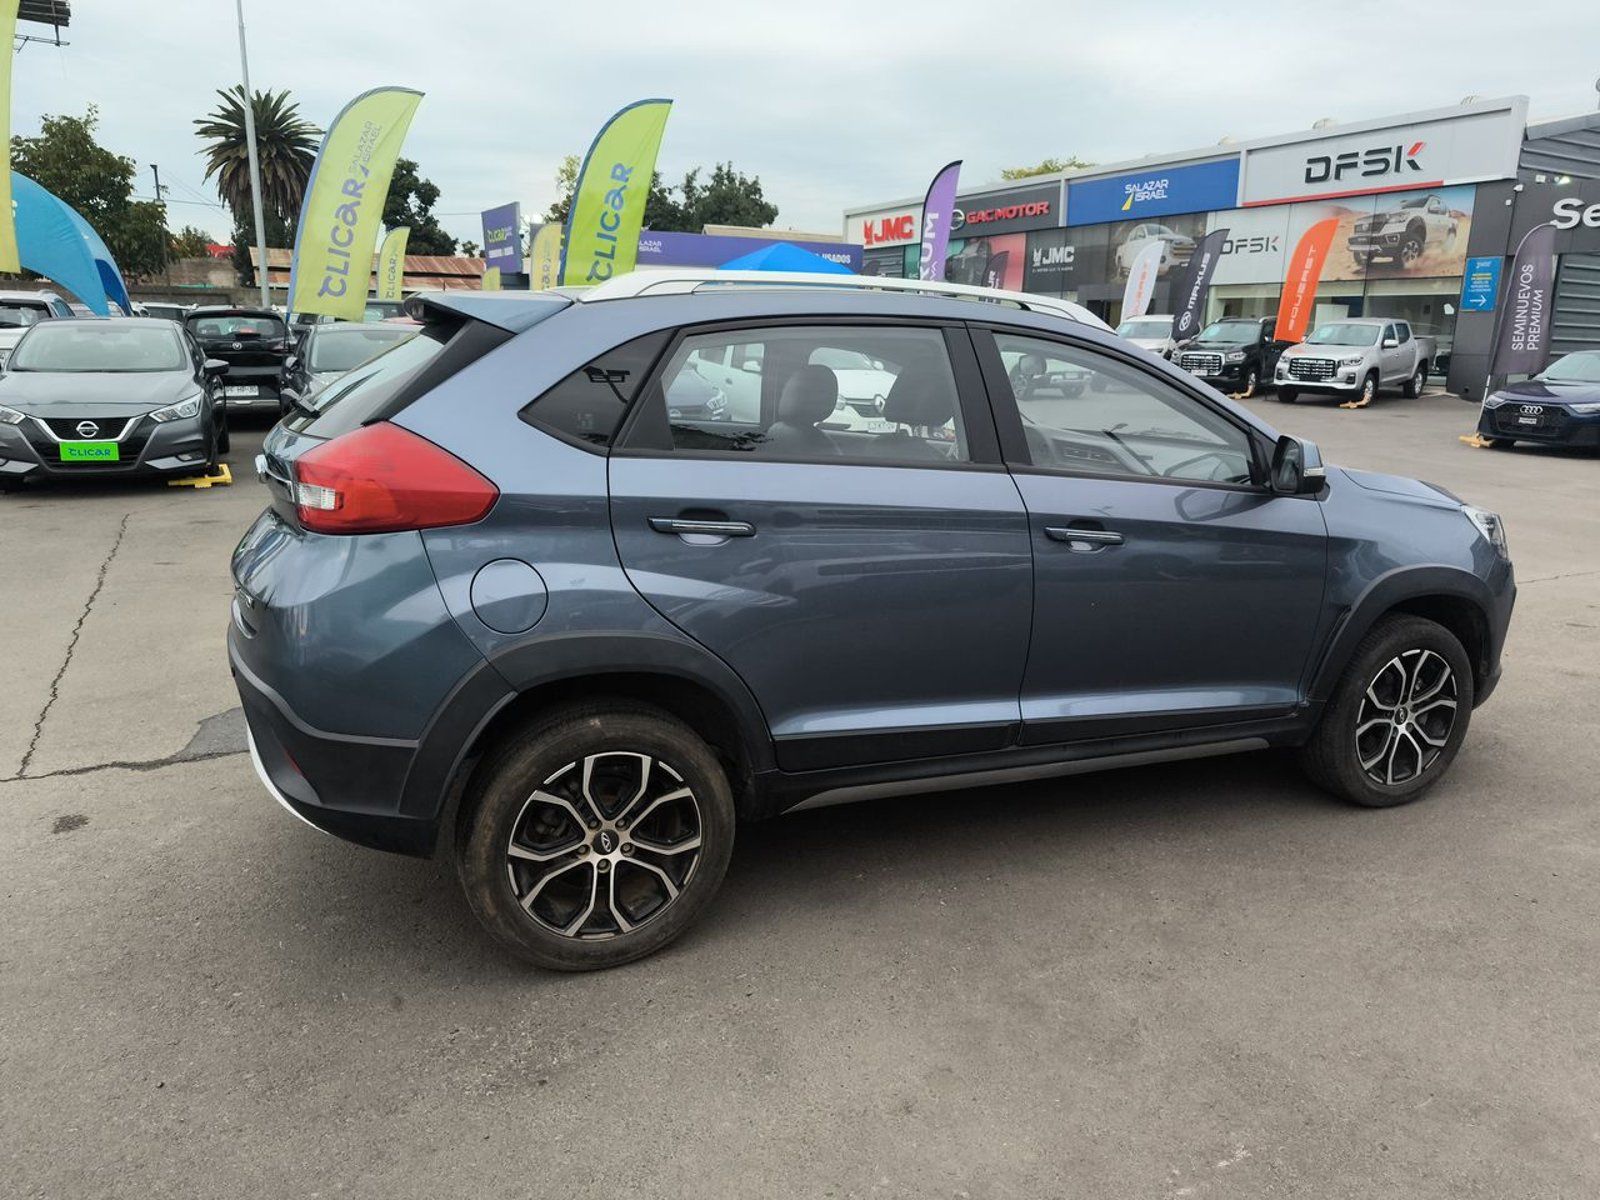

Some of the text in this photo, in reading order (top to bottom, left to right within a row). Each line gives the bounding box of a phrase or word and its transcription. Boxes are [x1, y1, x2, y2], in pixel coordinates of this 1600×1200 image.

[1304, 141, 1426, 184] DFSK
[1124, 179, 1169, 195] SALAZAR
[1134, 189, 1168, 202] ISRAEL
[874, 215, 914, 242] JMC
[1042, 246, 1075, 265] JMC
[1220, 236, 1279, 255] DFSK
[1512, 264, 1534, 351] SEMINUEVOS
[1526, 289, 1544, 351] PREMIUM
